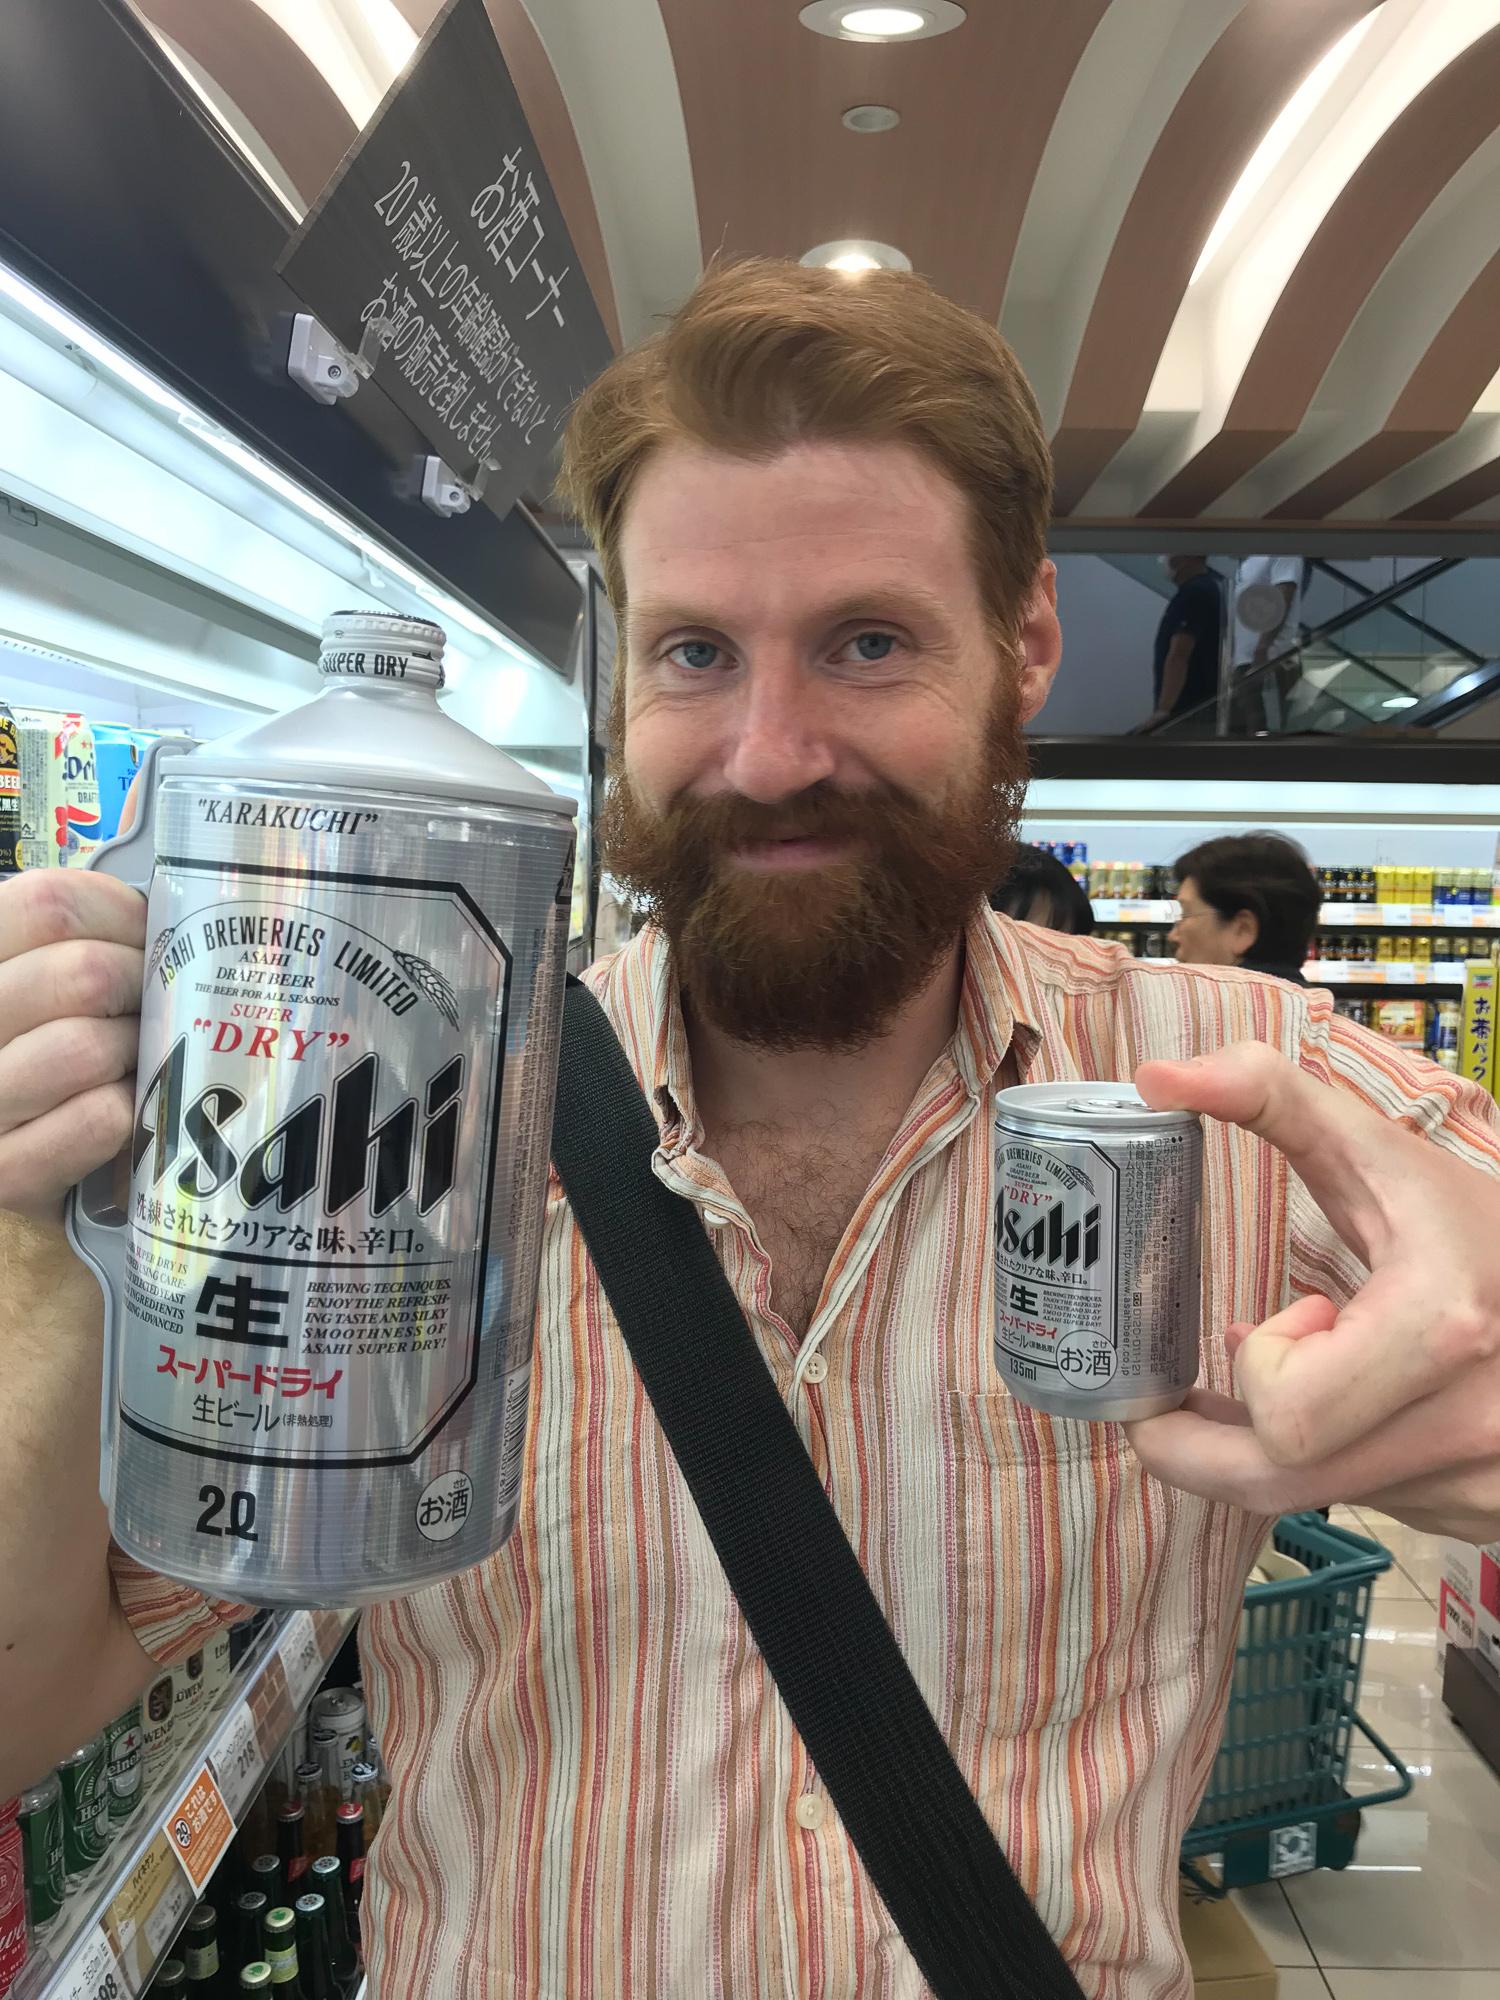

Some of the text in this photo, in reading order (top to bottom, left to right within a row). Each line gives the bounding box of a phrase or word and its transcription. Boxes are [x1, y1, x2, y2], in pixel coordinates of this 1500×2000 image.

[470, 147, 570, 327] お酒コーナー
[323, 652, 408, 678] SUPER DRY
[158, 916, 419, 1016] ASAHI BREWERIES LIMITED
[239, 950, 292, 967] ASAHI
[216, 967, 316, 989] DRAFT BEER
[195, 983, 340, 1007] THE BEER FOR ALL SEASONS
[231, 1003, 293, 1022] SUPER
[1470, 997, 1491, 1081] お茶パック
[132, 1032, 466, 1218] Asahi
[1006, 1148, 1042, 1166] BREWERIES
[1045, 1159, 1077, 1190] LIMITED
[136, 1191, 424, 1255] 洗練されたクリアな味、辛口。
[157, 1256, 177, 1271] DRY
[177, 1263, 188, 1275] IS
[996, 1250, 1087, 1285] されたクリアな味、辛口。
[160, 1287, 186, 1305] YEAST
[307, 1282, 371, 1294] BREWING
[1010, 1284, 1038, 1316] 生
[130, 1287, 185, 1320] INGREDIENTS
[195, 1275, 289, 1348] 生
[306, 1294, 451, 1309] ENJOY THE REFRESH-
[140, 1310, 184, 1335] ADVANCED
[304, 1308, 449, 1324] ING TASTE AND SILKY
[303, 1323, 448, 1339] SMOOTHNESS OF
[302, 1338, 446, 1354] ASAHI SUPER DRY!
[1092, 1340, 1107, 1349] さけ
[157, 1344, 343, 1399] スーパードライ
[1010, 1358, 1036, 1381] 135ml
[1060, 1347, 1111, 1377] お酒
[192, 1394, 280, 1432] 生ビール
[419, 1486, 469, 1527] お酒
[93, 1973, 117, 2000] 98
